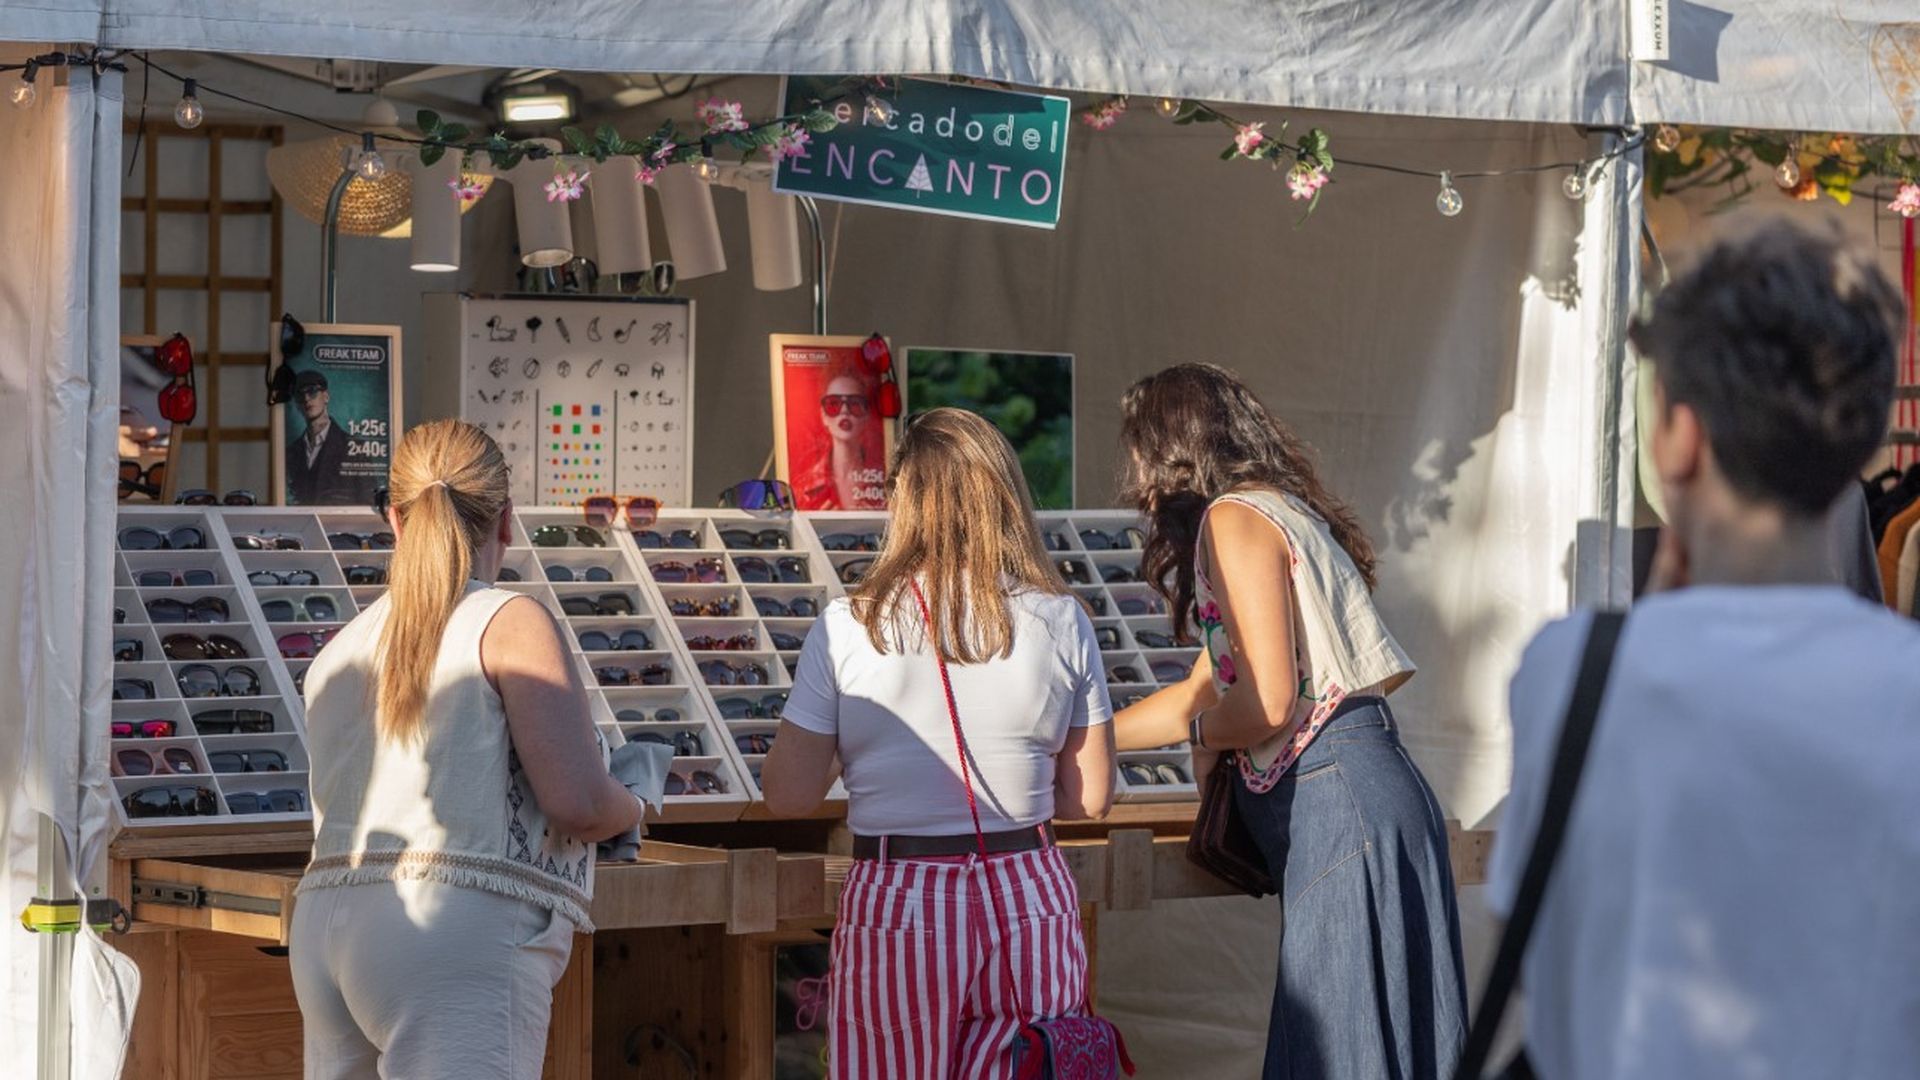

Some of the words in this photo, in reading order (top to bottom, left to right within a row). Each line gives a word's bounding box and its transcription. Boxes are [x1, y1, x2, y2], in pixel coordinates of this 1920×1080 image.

[318, 347, 350, 360] FREAK
[351, 349, 380, 361] TEAM
[348, 419, 387, 436] 1x25€
[347, 440, 387, 457] 2x40€
